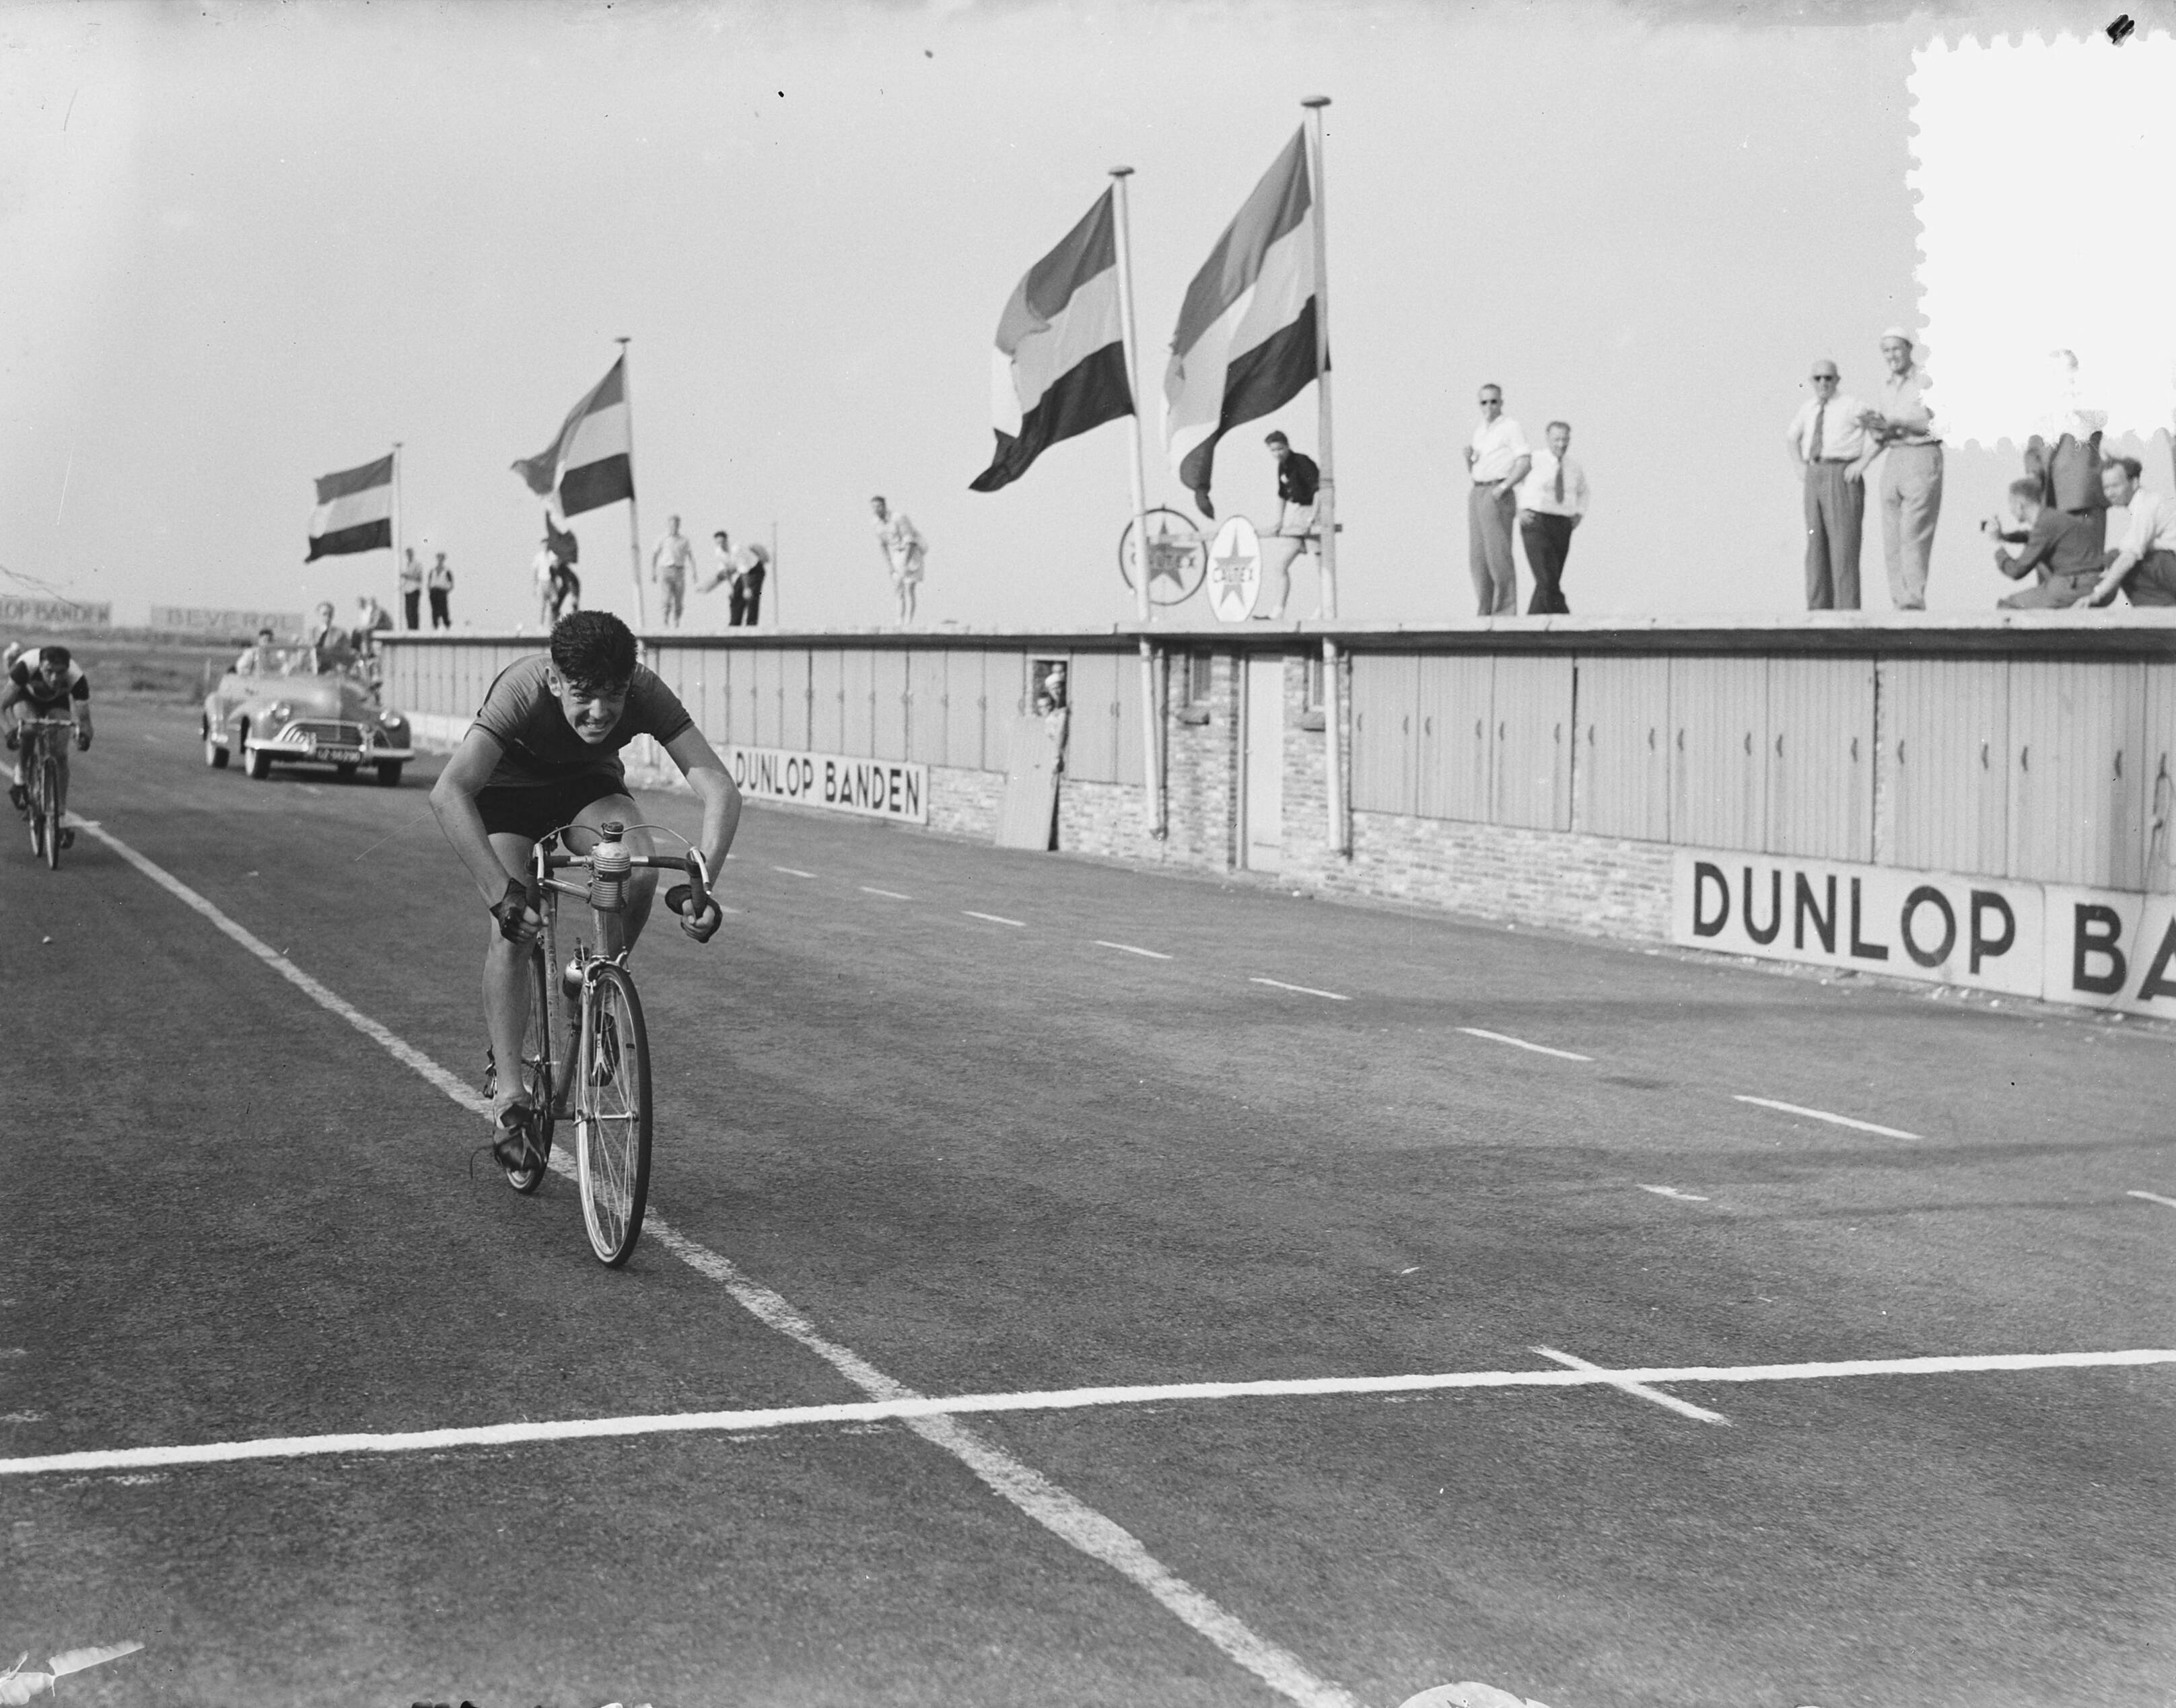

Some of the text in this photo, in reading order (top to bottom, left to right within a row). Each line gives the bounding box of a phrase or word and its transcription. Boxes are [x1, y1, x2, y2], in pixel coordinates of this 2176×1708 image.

[736, 752, 921, 816] DUNLOP BANDEN
[1693, 862, 2016, 974] DUNLOP
